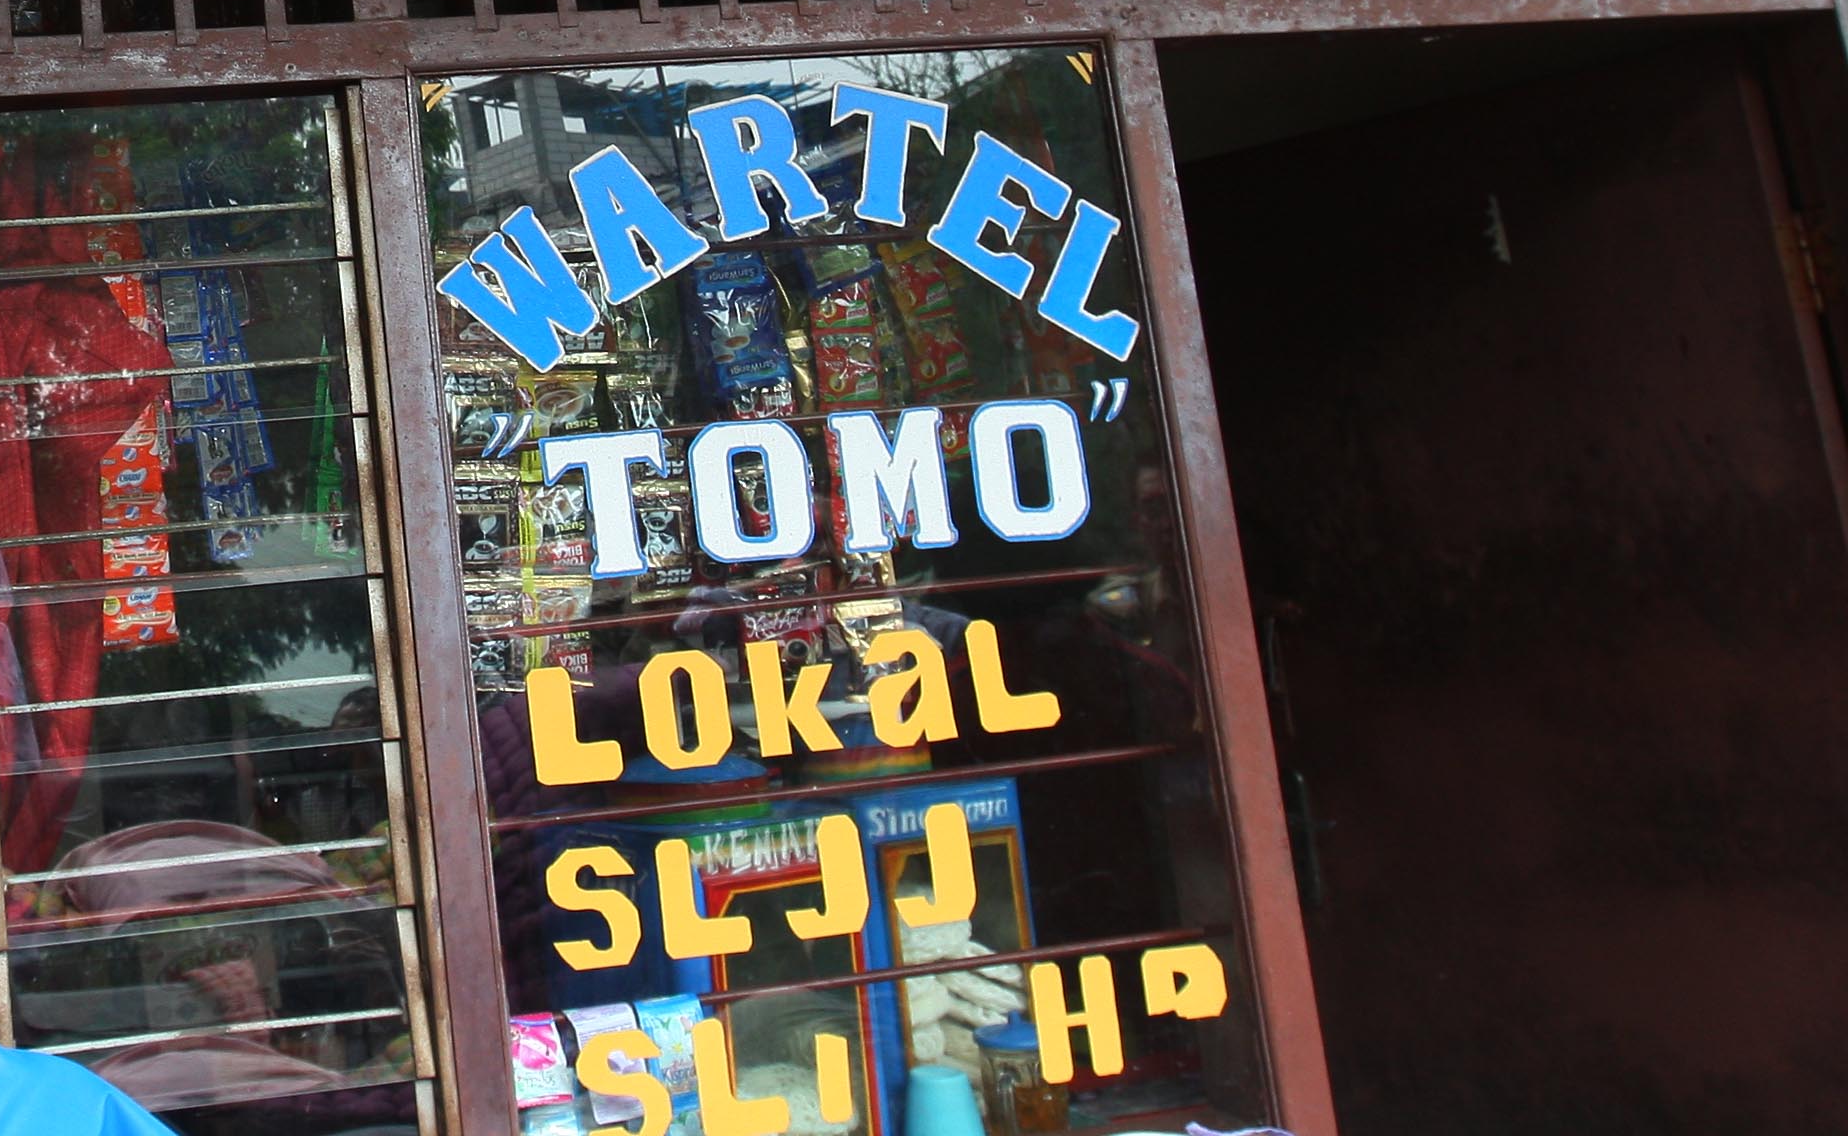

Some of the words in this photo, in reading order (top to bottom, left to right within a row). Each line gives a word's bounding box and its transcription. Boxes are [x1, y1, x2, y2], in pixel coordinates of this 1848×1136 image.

[436, 81, 1140, 373] WARTEL
[565, 416, 599, 431] Susu
[553, 544, 583, 556] BIKA
[559, 652, 588, 665] BIKA
[545, 803, 977, 971] SLJJ
[1030, 944, 1228, 1085] HP
